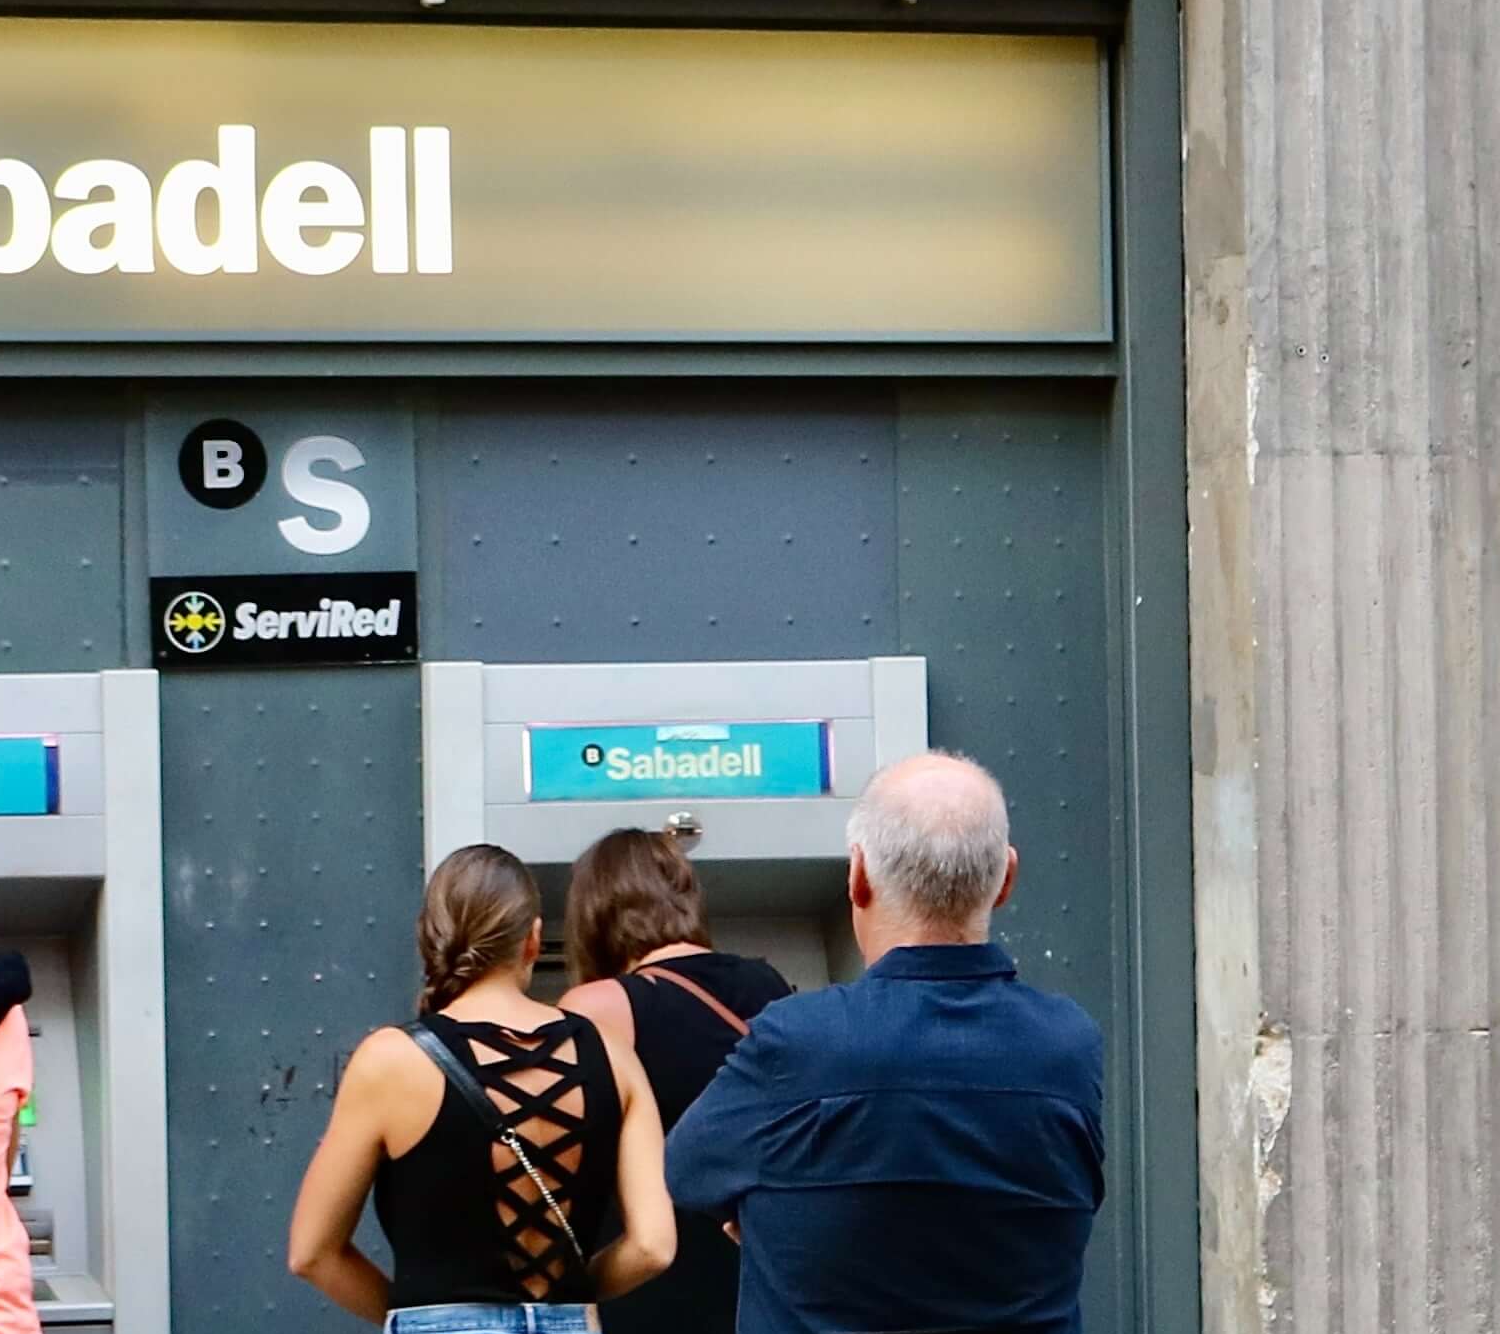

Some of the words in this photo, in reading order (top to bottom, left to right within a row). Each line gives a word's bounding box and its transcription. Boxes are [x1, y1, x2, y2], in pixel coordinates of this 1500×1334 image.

[276, 434, 371, 556] S
[232, 597, 401, 641] ServiRed
[606, 743, 762, 782] Sabadell
